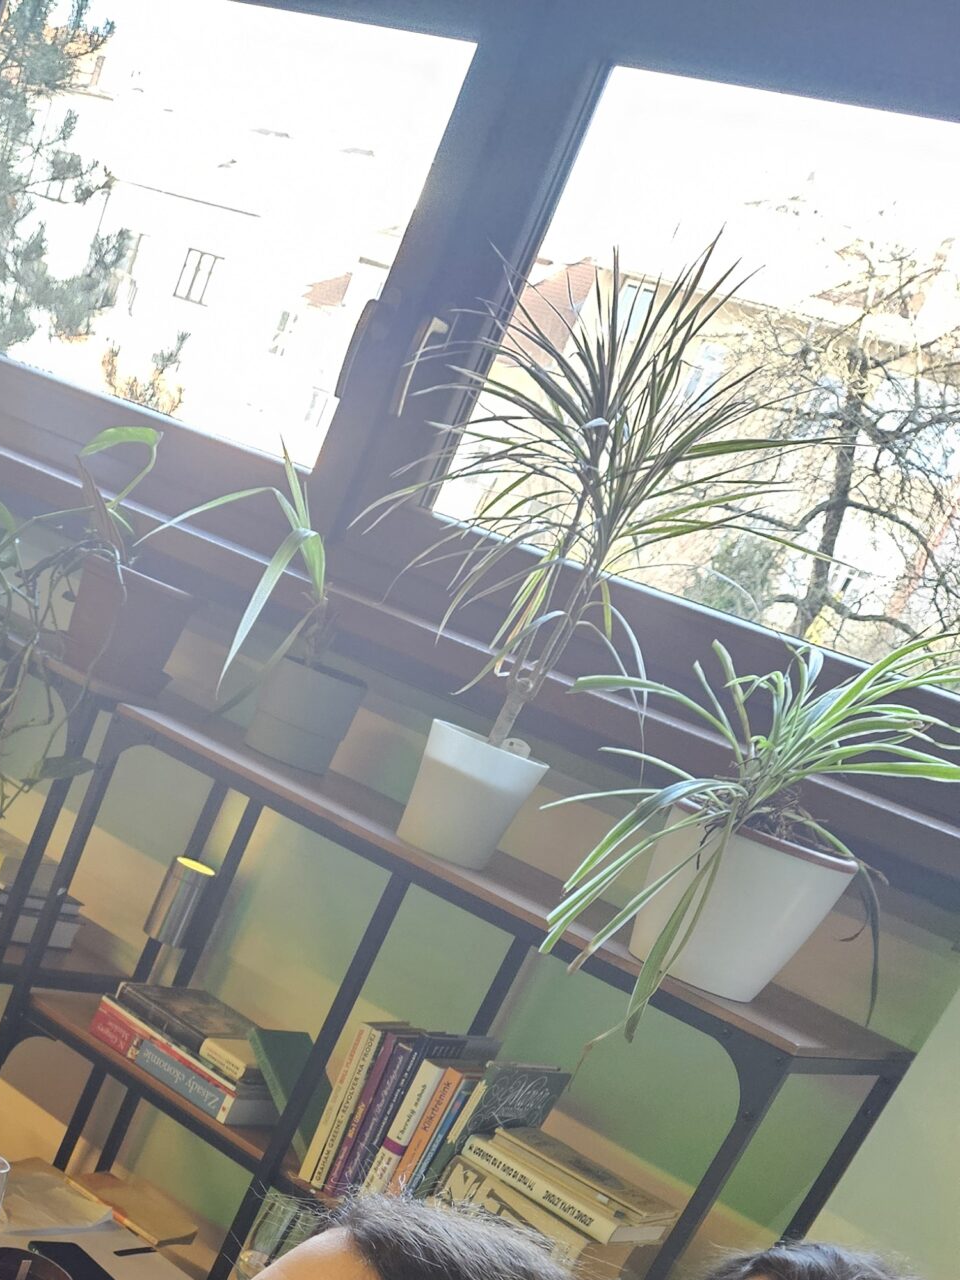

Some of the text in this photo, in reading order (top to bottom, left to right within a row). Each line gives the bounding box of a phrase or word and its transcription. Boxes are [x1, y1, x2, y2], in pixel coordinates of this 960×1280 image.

[143, 1048, 185, 1084] ekonomie
[187, 1076, 220, 1110] Zásady
[315, 1149, 331, 1181] GRAHAM
[329, 1120, 341, 1148] GREENE
[342, 1077, 360, 1114] REVOLVER
[358, 1064, 365, 1076] NA
[363, 1034, 377, 1060] PRODEJ
[421, 1080, 452, 1133] Klikrtrénink
